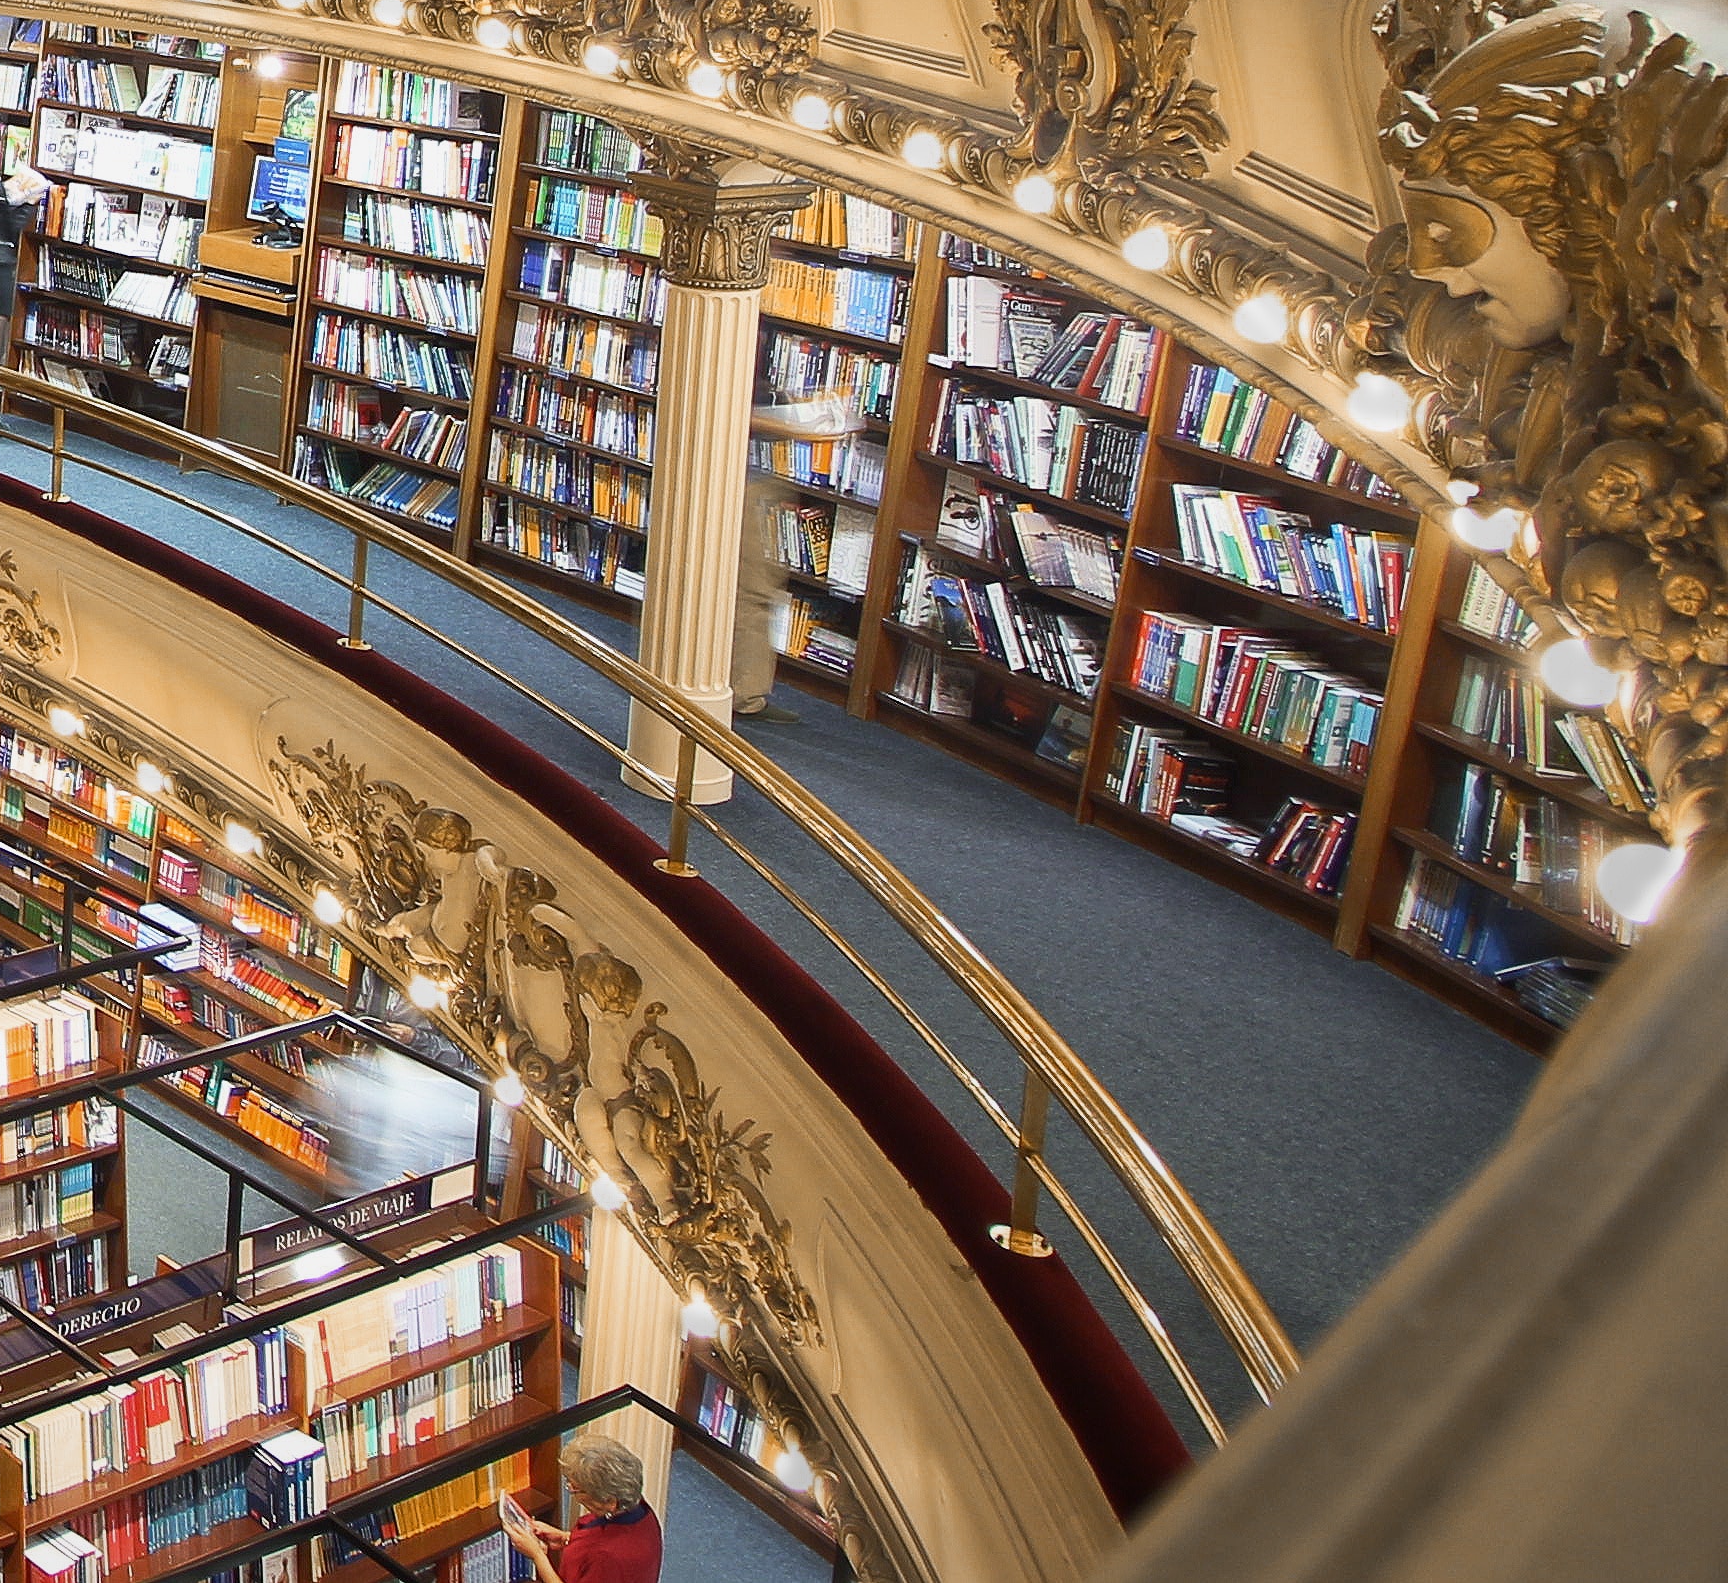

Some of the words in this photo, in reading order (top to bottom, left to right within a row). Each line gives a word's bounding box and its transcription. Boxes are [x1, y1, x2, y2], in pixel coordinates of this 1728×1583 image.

[349, 1205, 371, 1227] DE
[374, 1191, 416, 1217] VIAJE
[57, 1297, 142, 1337] DERECHO
